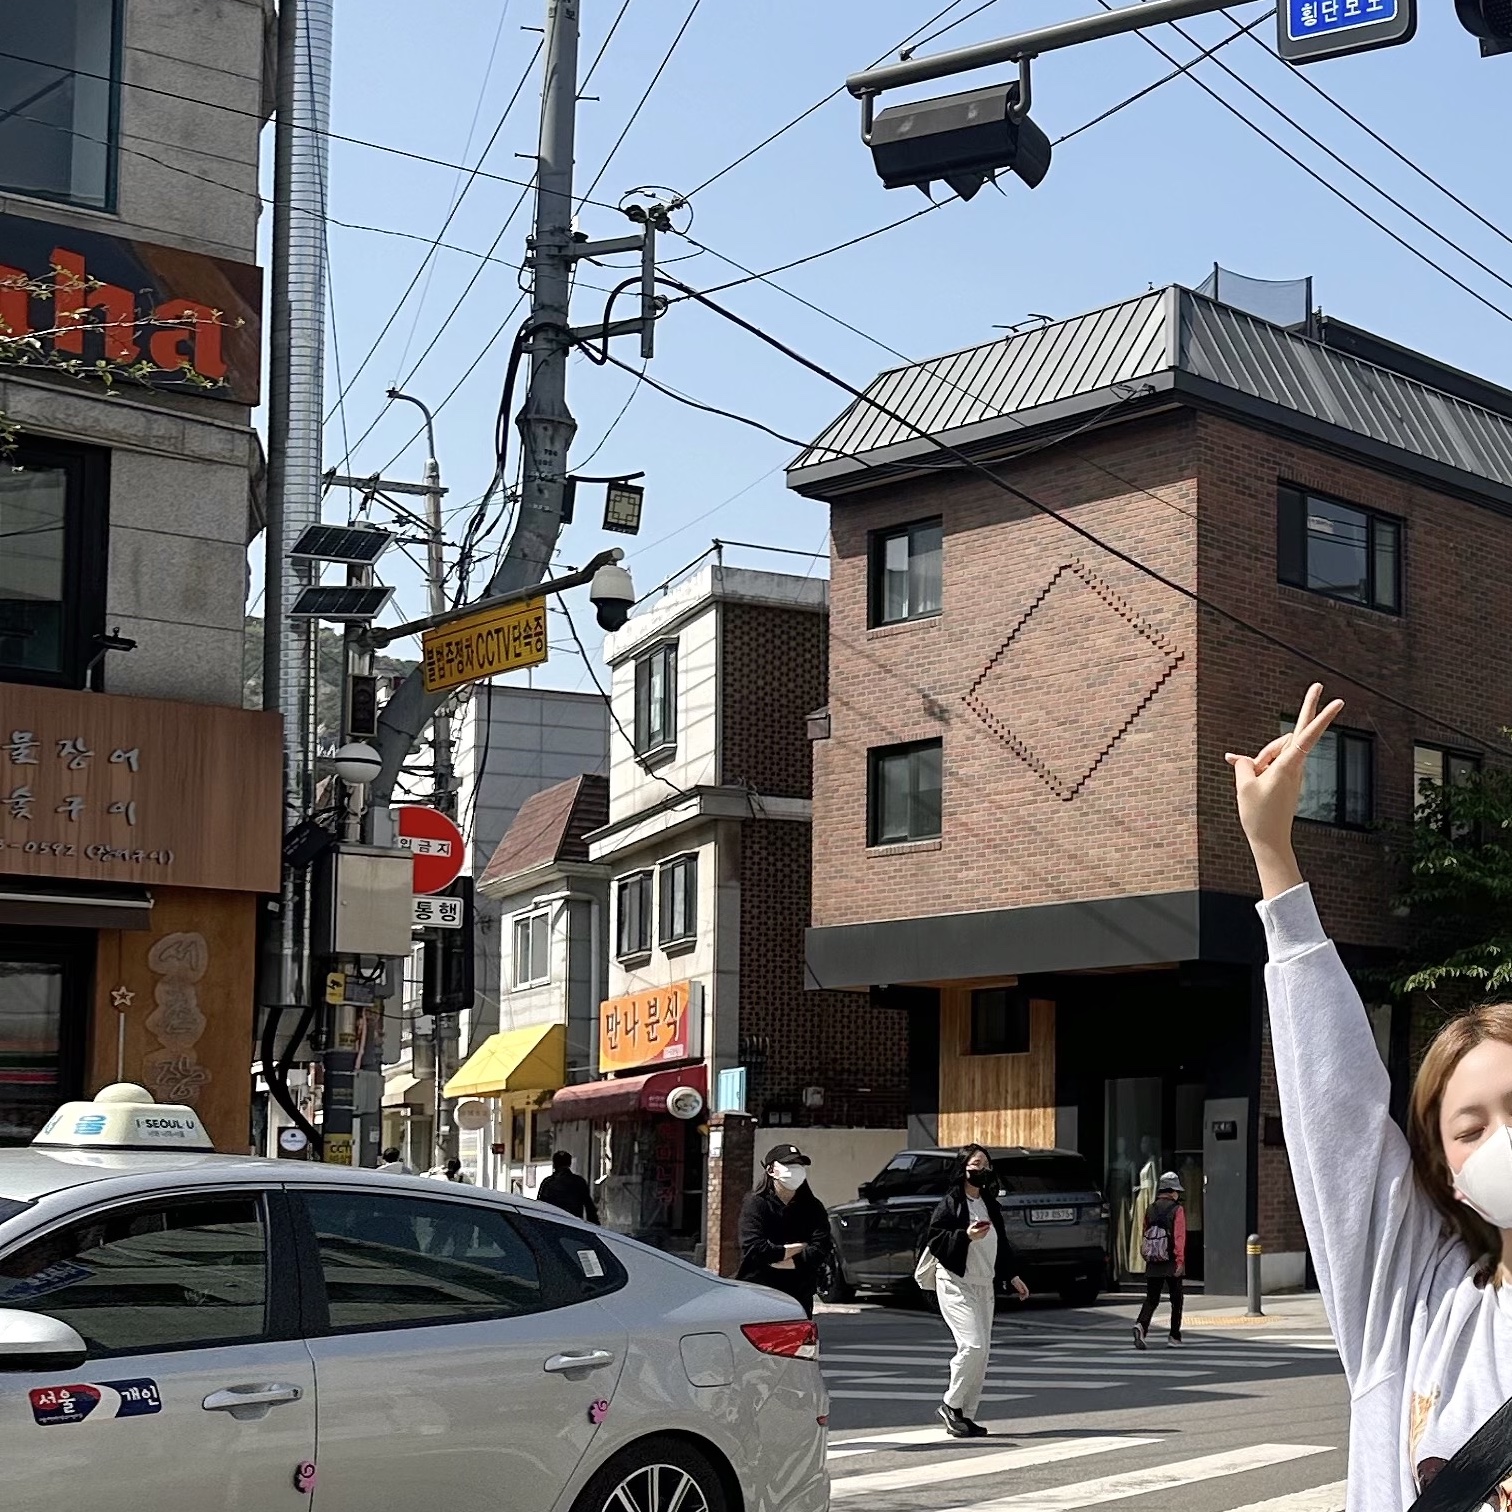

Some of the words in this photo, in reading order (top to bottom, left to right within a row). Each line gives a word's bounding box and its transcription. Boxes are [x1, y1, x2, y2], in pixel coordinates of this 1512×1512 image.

[145, 1118, 183, 1128] SEOUL
[39, 1389, 77, 1414] 서울
[121, 1385, 159, 1406] 개인
